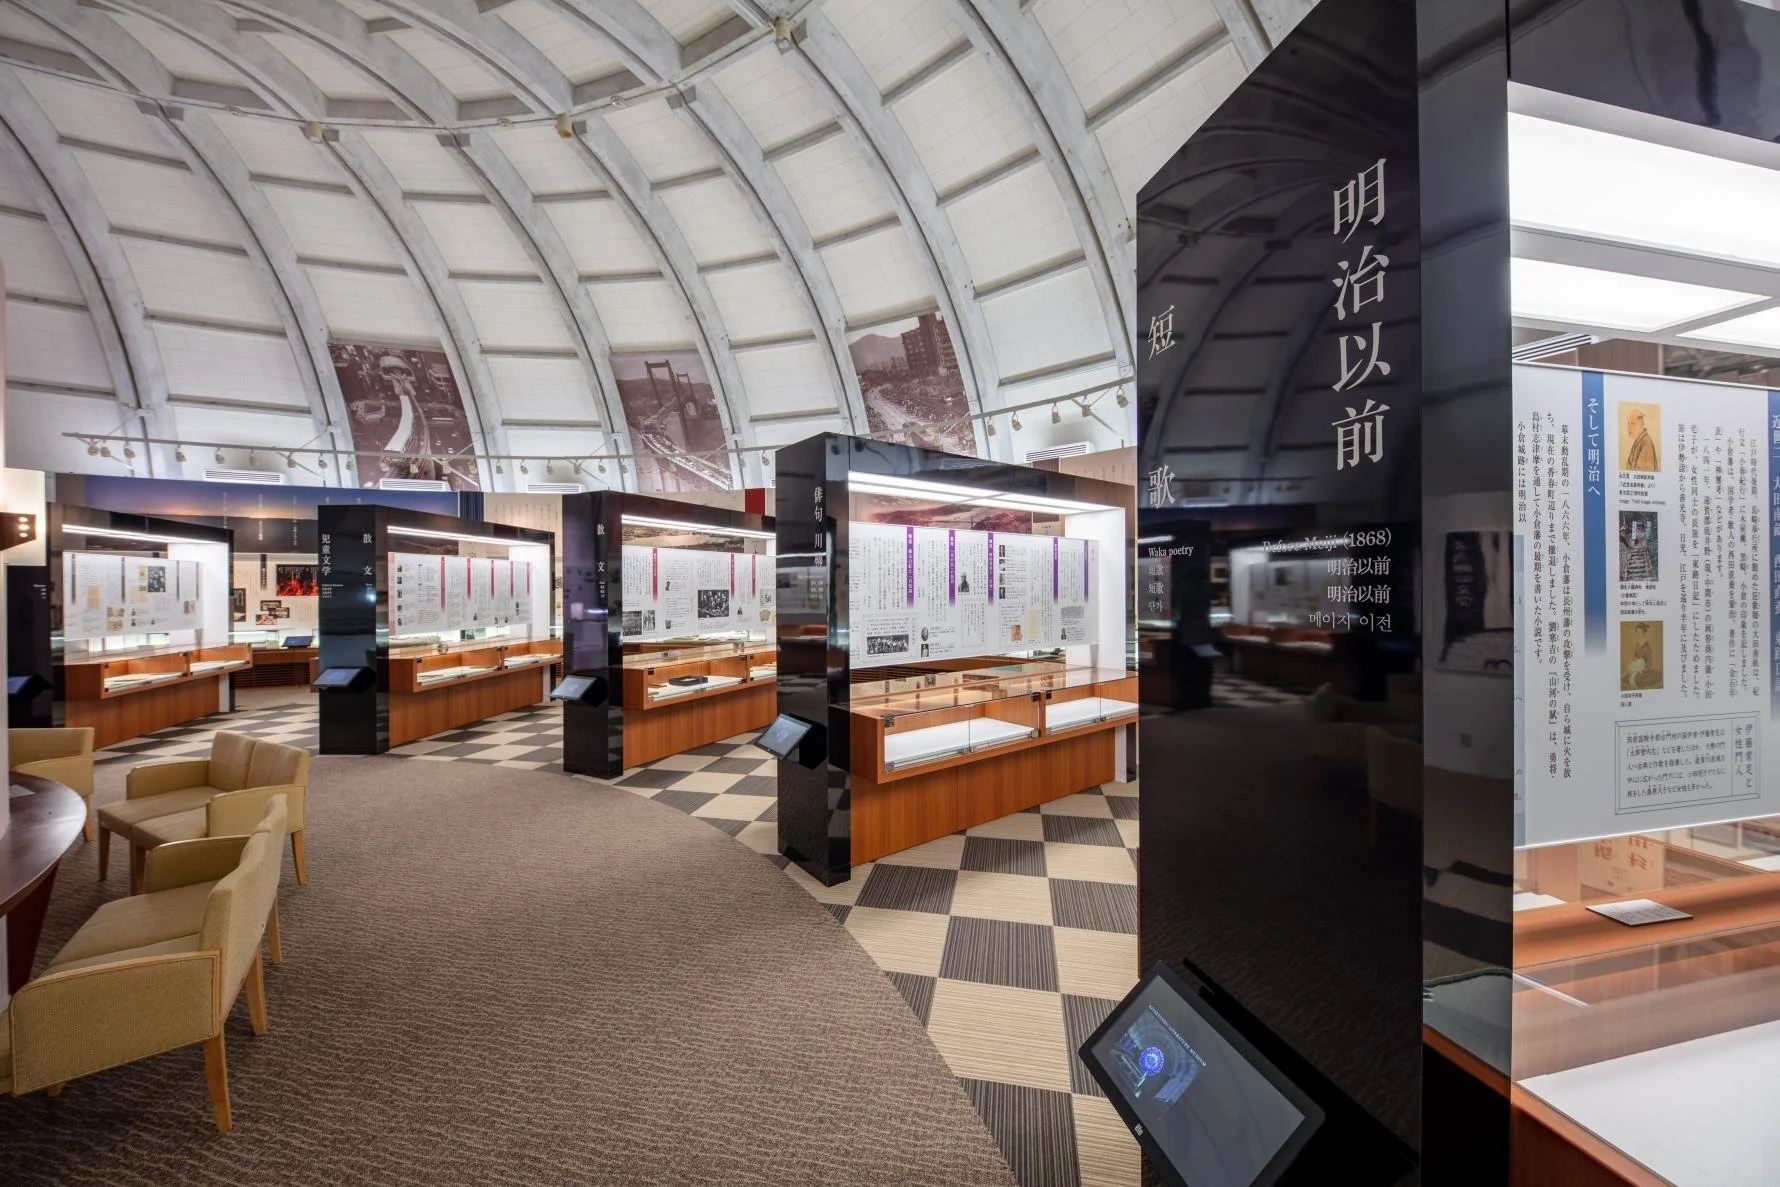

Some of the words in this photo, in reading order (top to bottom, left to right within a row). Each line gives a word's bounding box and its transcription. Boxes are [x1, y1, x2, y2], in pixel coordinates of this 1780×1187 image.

[1332, 158, 1390, 471] 明治以前
[1587, 398, 1602, 496] そして明治へ
[813, 486, 823, 522] 俳句
[1148, 546, 1167, 557] Waka
[1168, 546, 1194, 558] poetry
[1262, 540, 1301, 553] Before
[1304, 535, 1338, 551] Meiji
[1343, 527, 1392, 550] (1868)
[321, 533, 331, 576] 児童文学
[1327, 555, 1392, 576] 明治以前
[1148, 582, 1164, 594] 短歌
[1327, 584, 1392, 604] 明治以前
[1309, 611, 1351, 631] 메이지
[1359, 613, 1393, 632] 이전
[1735, 725, 1743, 776] 女性門人
